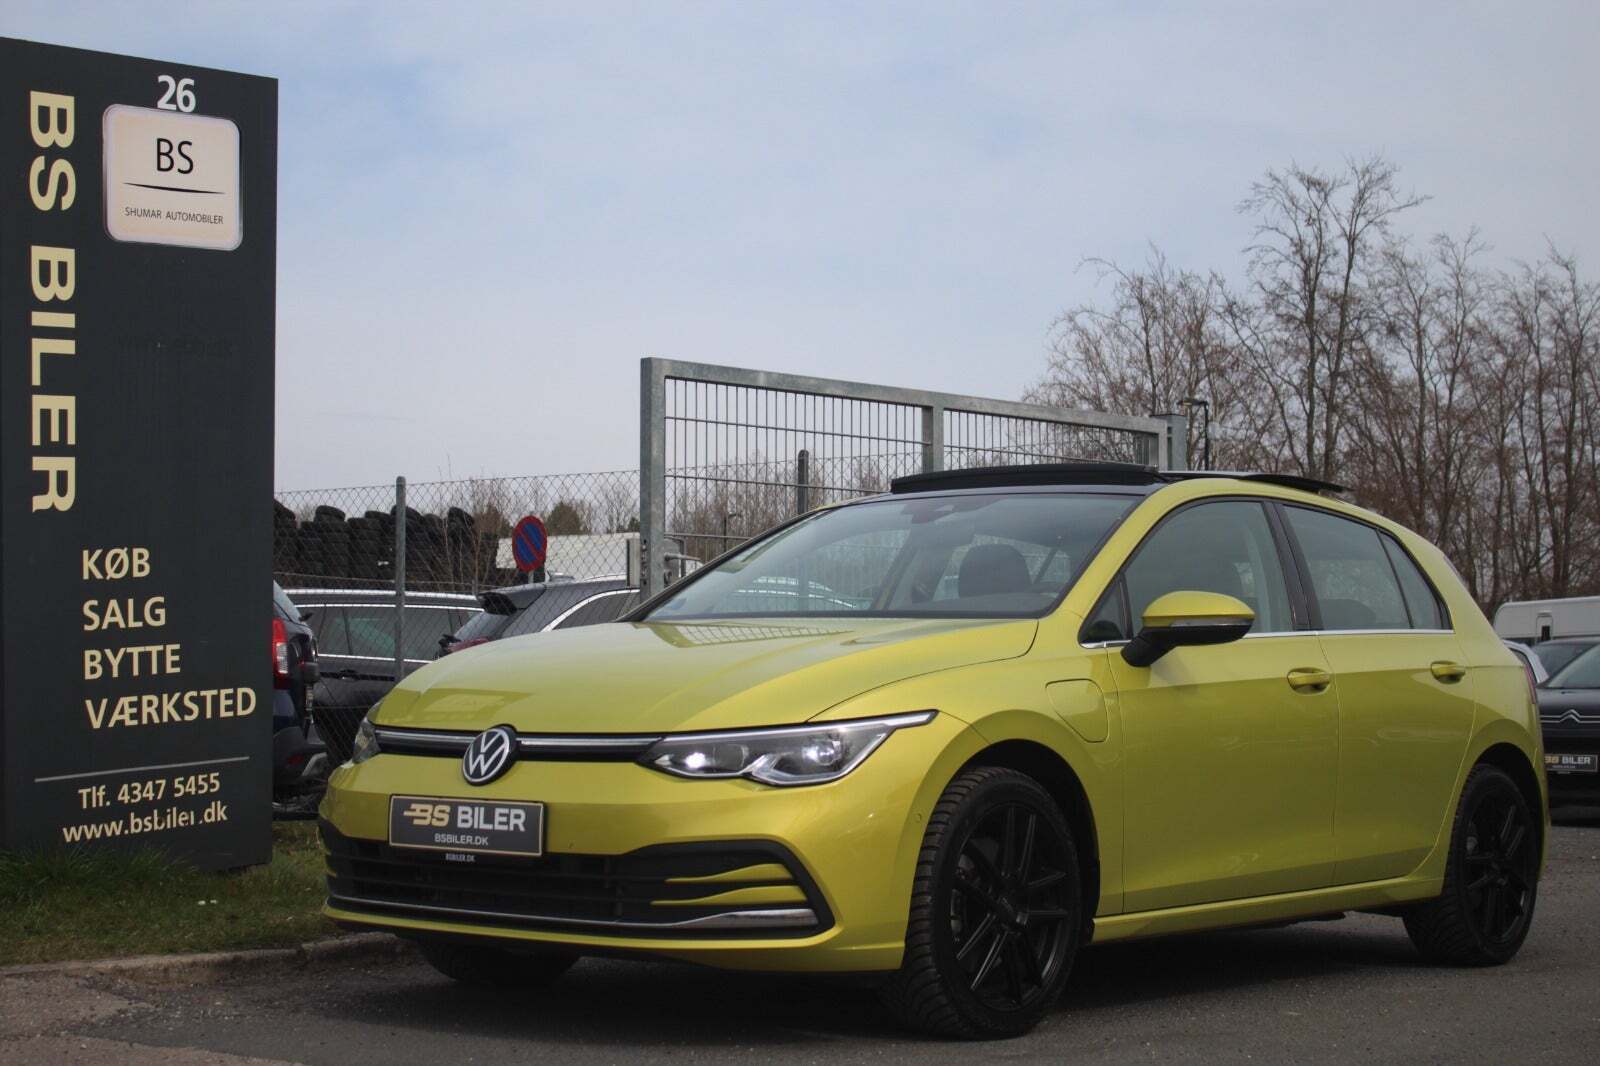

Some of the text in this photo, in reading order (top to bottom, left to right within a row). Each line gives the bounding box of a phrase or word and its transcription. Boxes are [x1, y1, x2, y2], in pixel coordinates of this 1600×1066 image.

[157, 74, 196, 113] 26
[156, 137, 194, 175] BS
[125, 206, 224, 226] SHUMAR AUTOMOBILER
[29, 90, 76, 513] BS BILER
[82, 547, 150, 580] KØB
[83, 596, 166, 631] SALG
[83, 643, 181, 680] BYTTE
[85, 687, 257, 729] VÆRKSTED
[1562, 755, 1591, 764] BILER
[78, 772, 221, 809] Tlf. 4347 5455
[457, 805, 526, 831] BILER
[434, 832, 489, 846] BSBILER.DK
